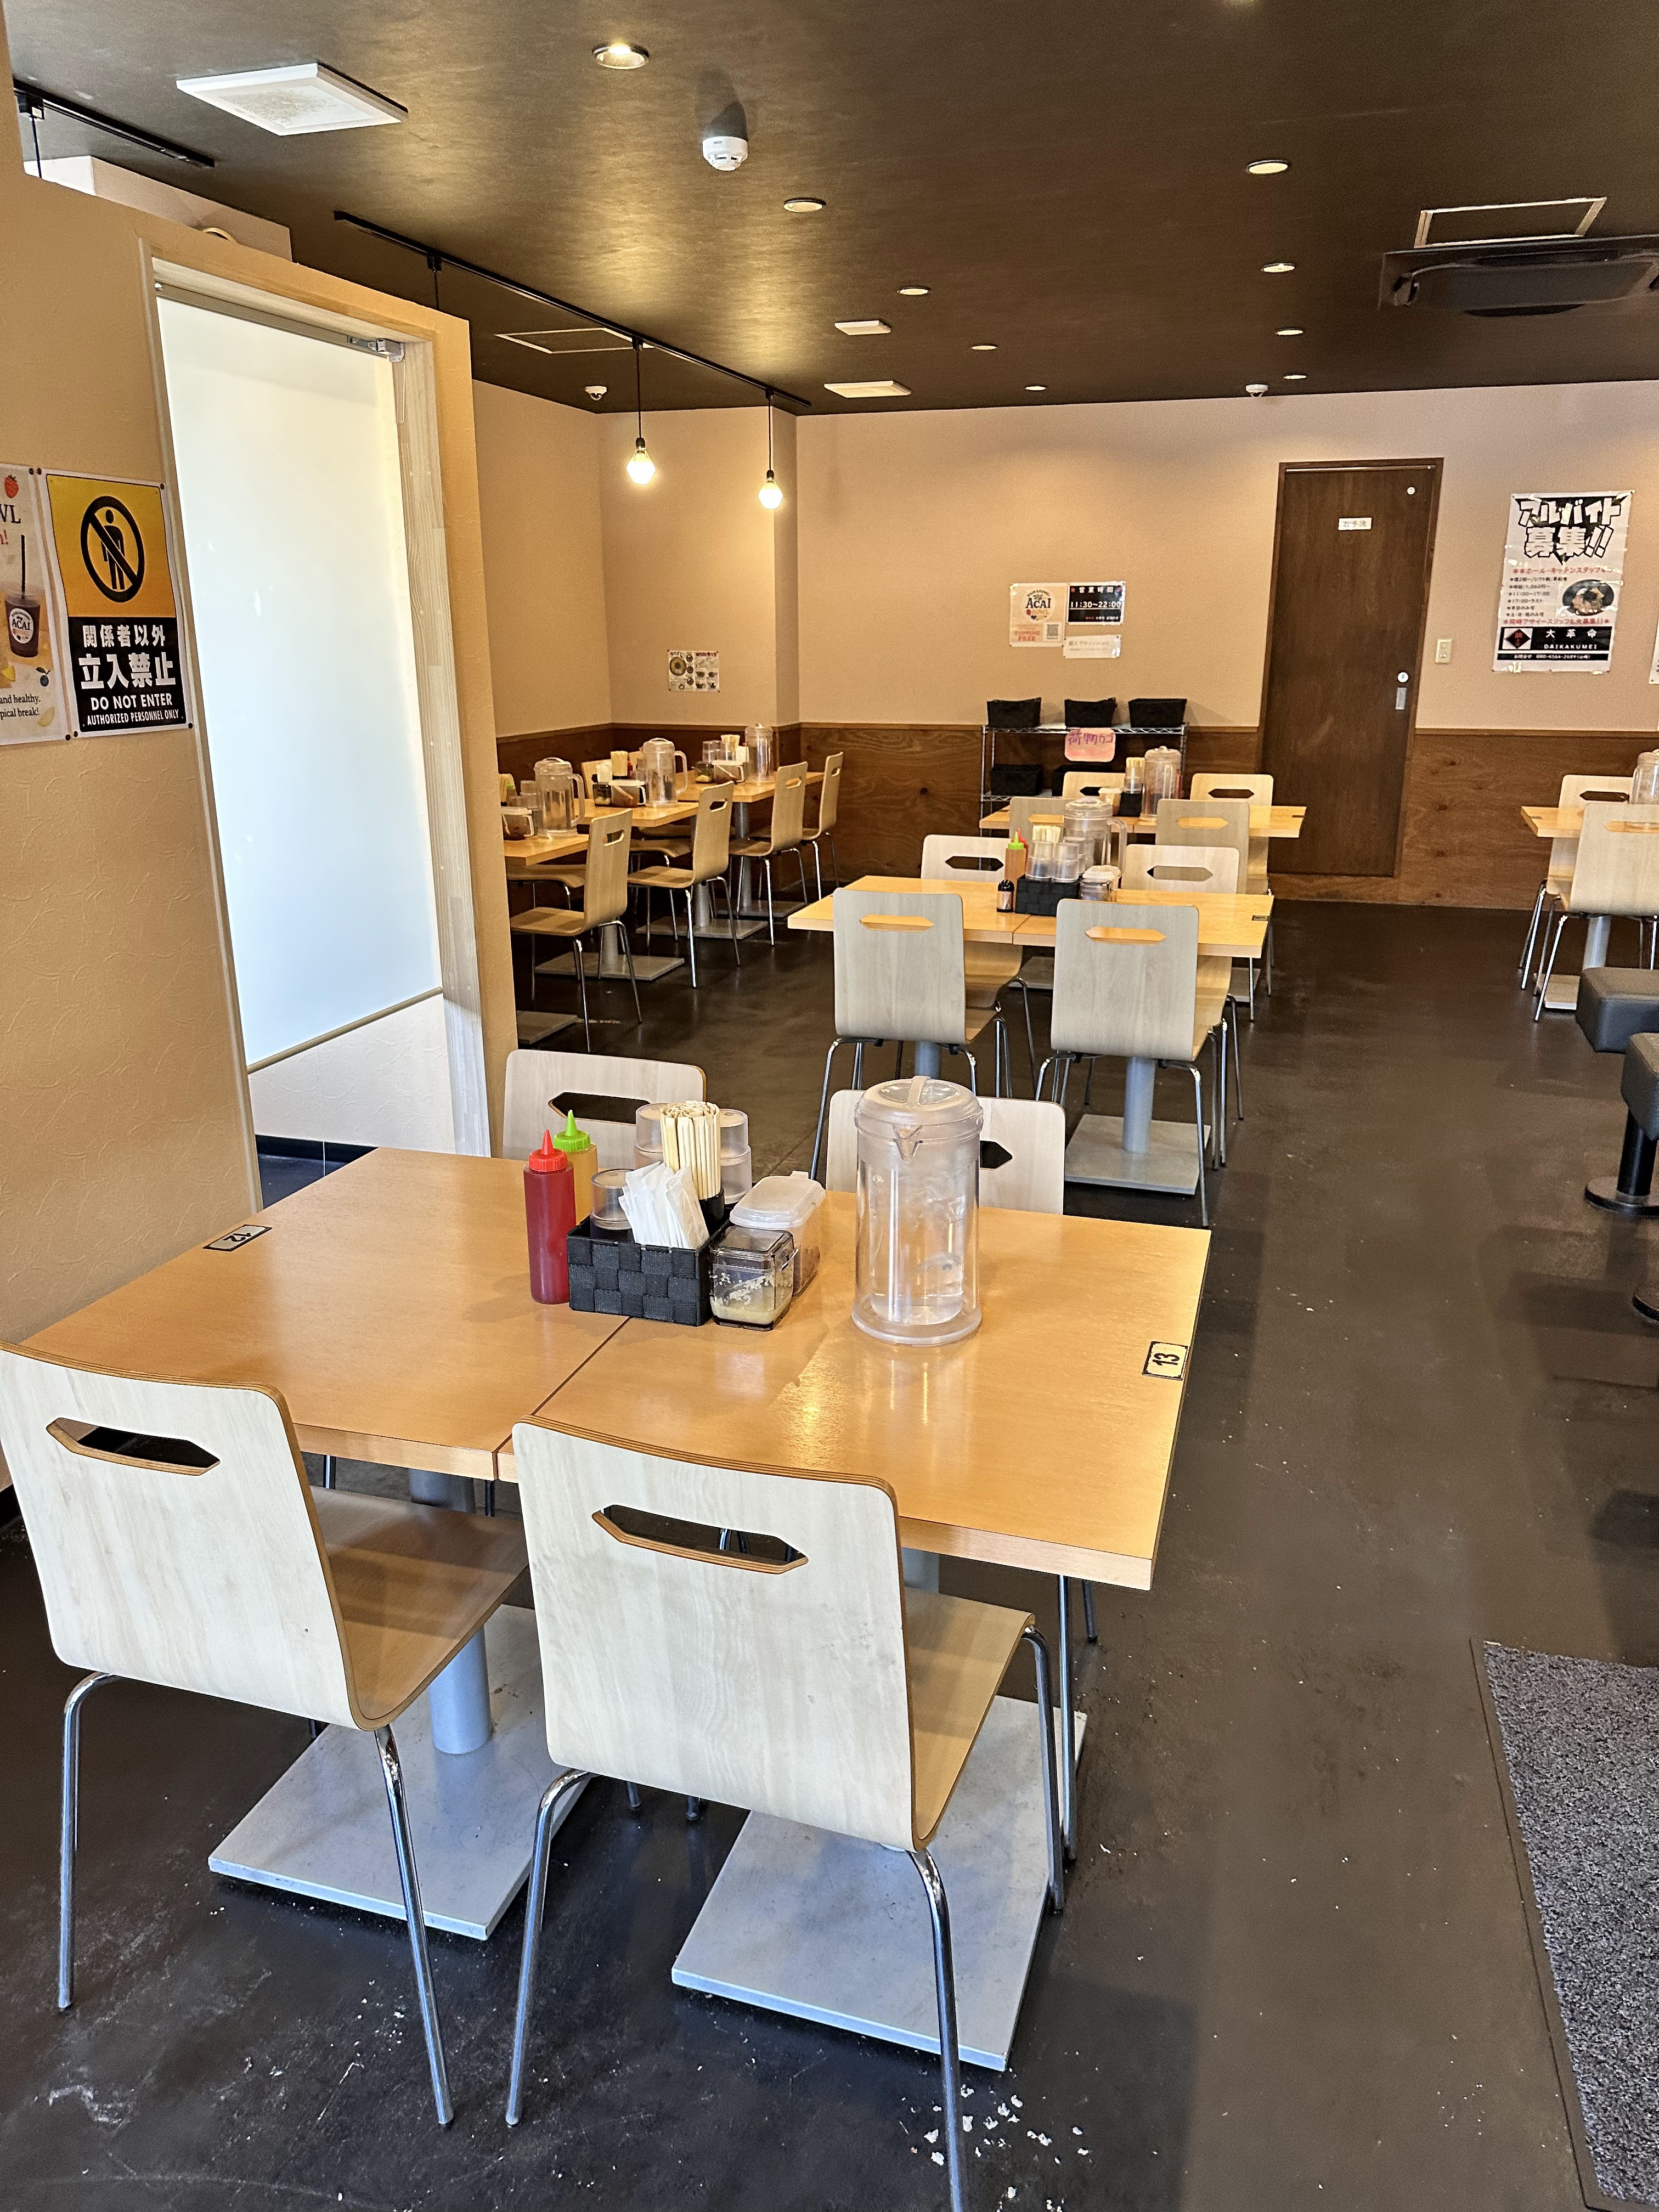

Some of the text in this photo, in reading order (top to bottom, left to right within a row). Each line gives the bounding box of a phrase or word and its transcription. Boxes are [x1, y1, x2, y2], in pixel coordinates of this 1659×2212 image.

[1518, 498, 1621, 527] アルバイト
[82, 624, 165, 648] 関係者以外
[1545, 629, 1597, 639] 大革命
[78, 651, 176, 690] 立入禁止
[13, 693, 41, 705] healthy.
[91, 693, 173, 710] DO NOT ENTER
[17, 707, 40, 716] break!
[87, 709, 179, 726] AUTHORIZED PERSONNEL ONLY
[1152, 1353, 1180, 1366] 13
